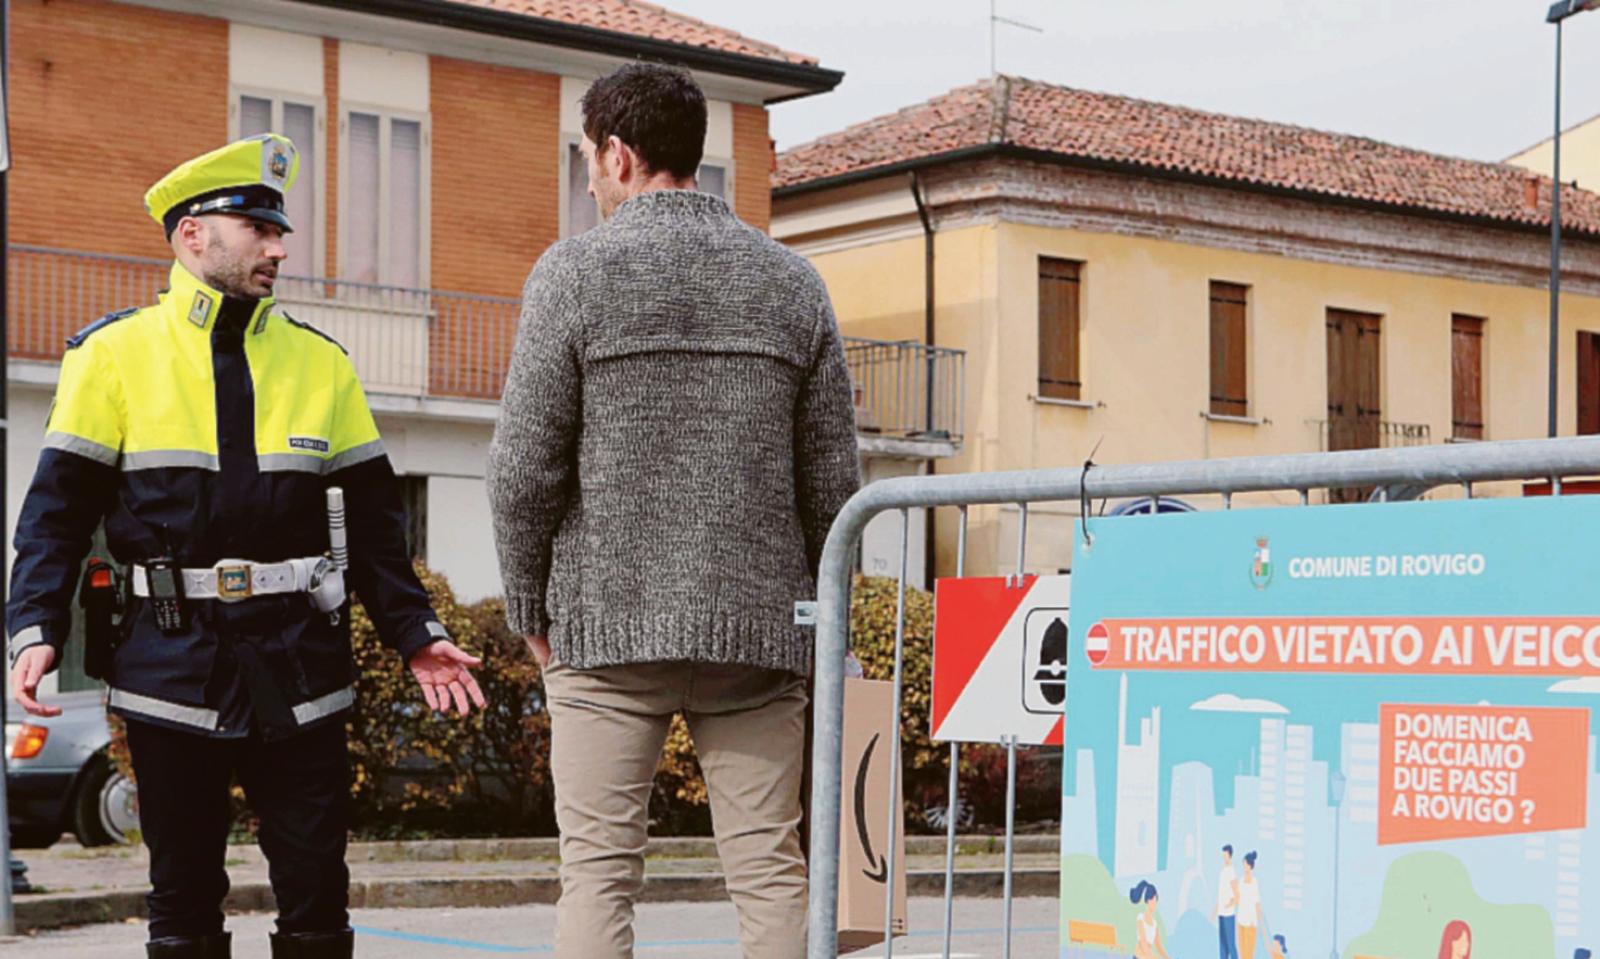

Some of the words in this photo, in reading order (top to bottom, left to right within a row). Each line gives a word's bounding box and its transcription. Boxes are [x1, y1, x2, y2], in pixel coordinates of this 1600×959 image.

[1288, 556, 1372, 578] COMUNE
[1375, 556, 1397, 576] DI
[1401, 553, 1485, 576] ROVIGO
[1119, 625, 1266, 663] TRAFFICO
[1272, 625, 1424, 666] VIETATO
[1430, 625, 1473, 666] AI
[1394, 713, 1533, 742] DOMENICA
[1394, 740, 1526, 769] FACCIAMO
[1393, 767, 1443, 792] DUE
[1448, 769, 1518, 796] PASSI
[1391, 794, 1411, 817] A
[1415, 794, 1515, 824] ROVIGO
[1520, 799, 1536, 825] ?
